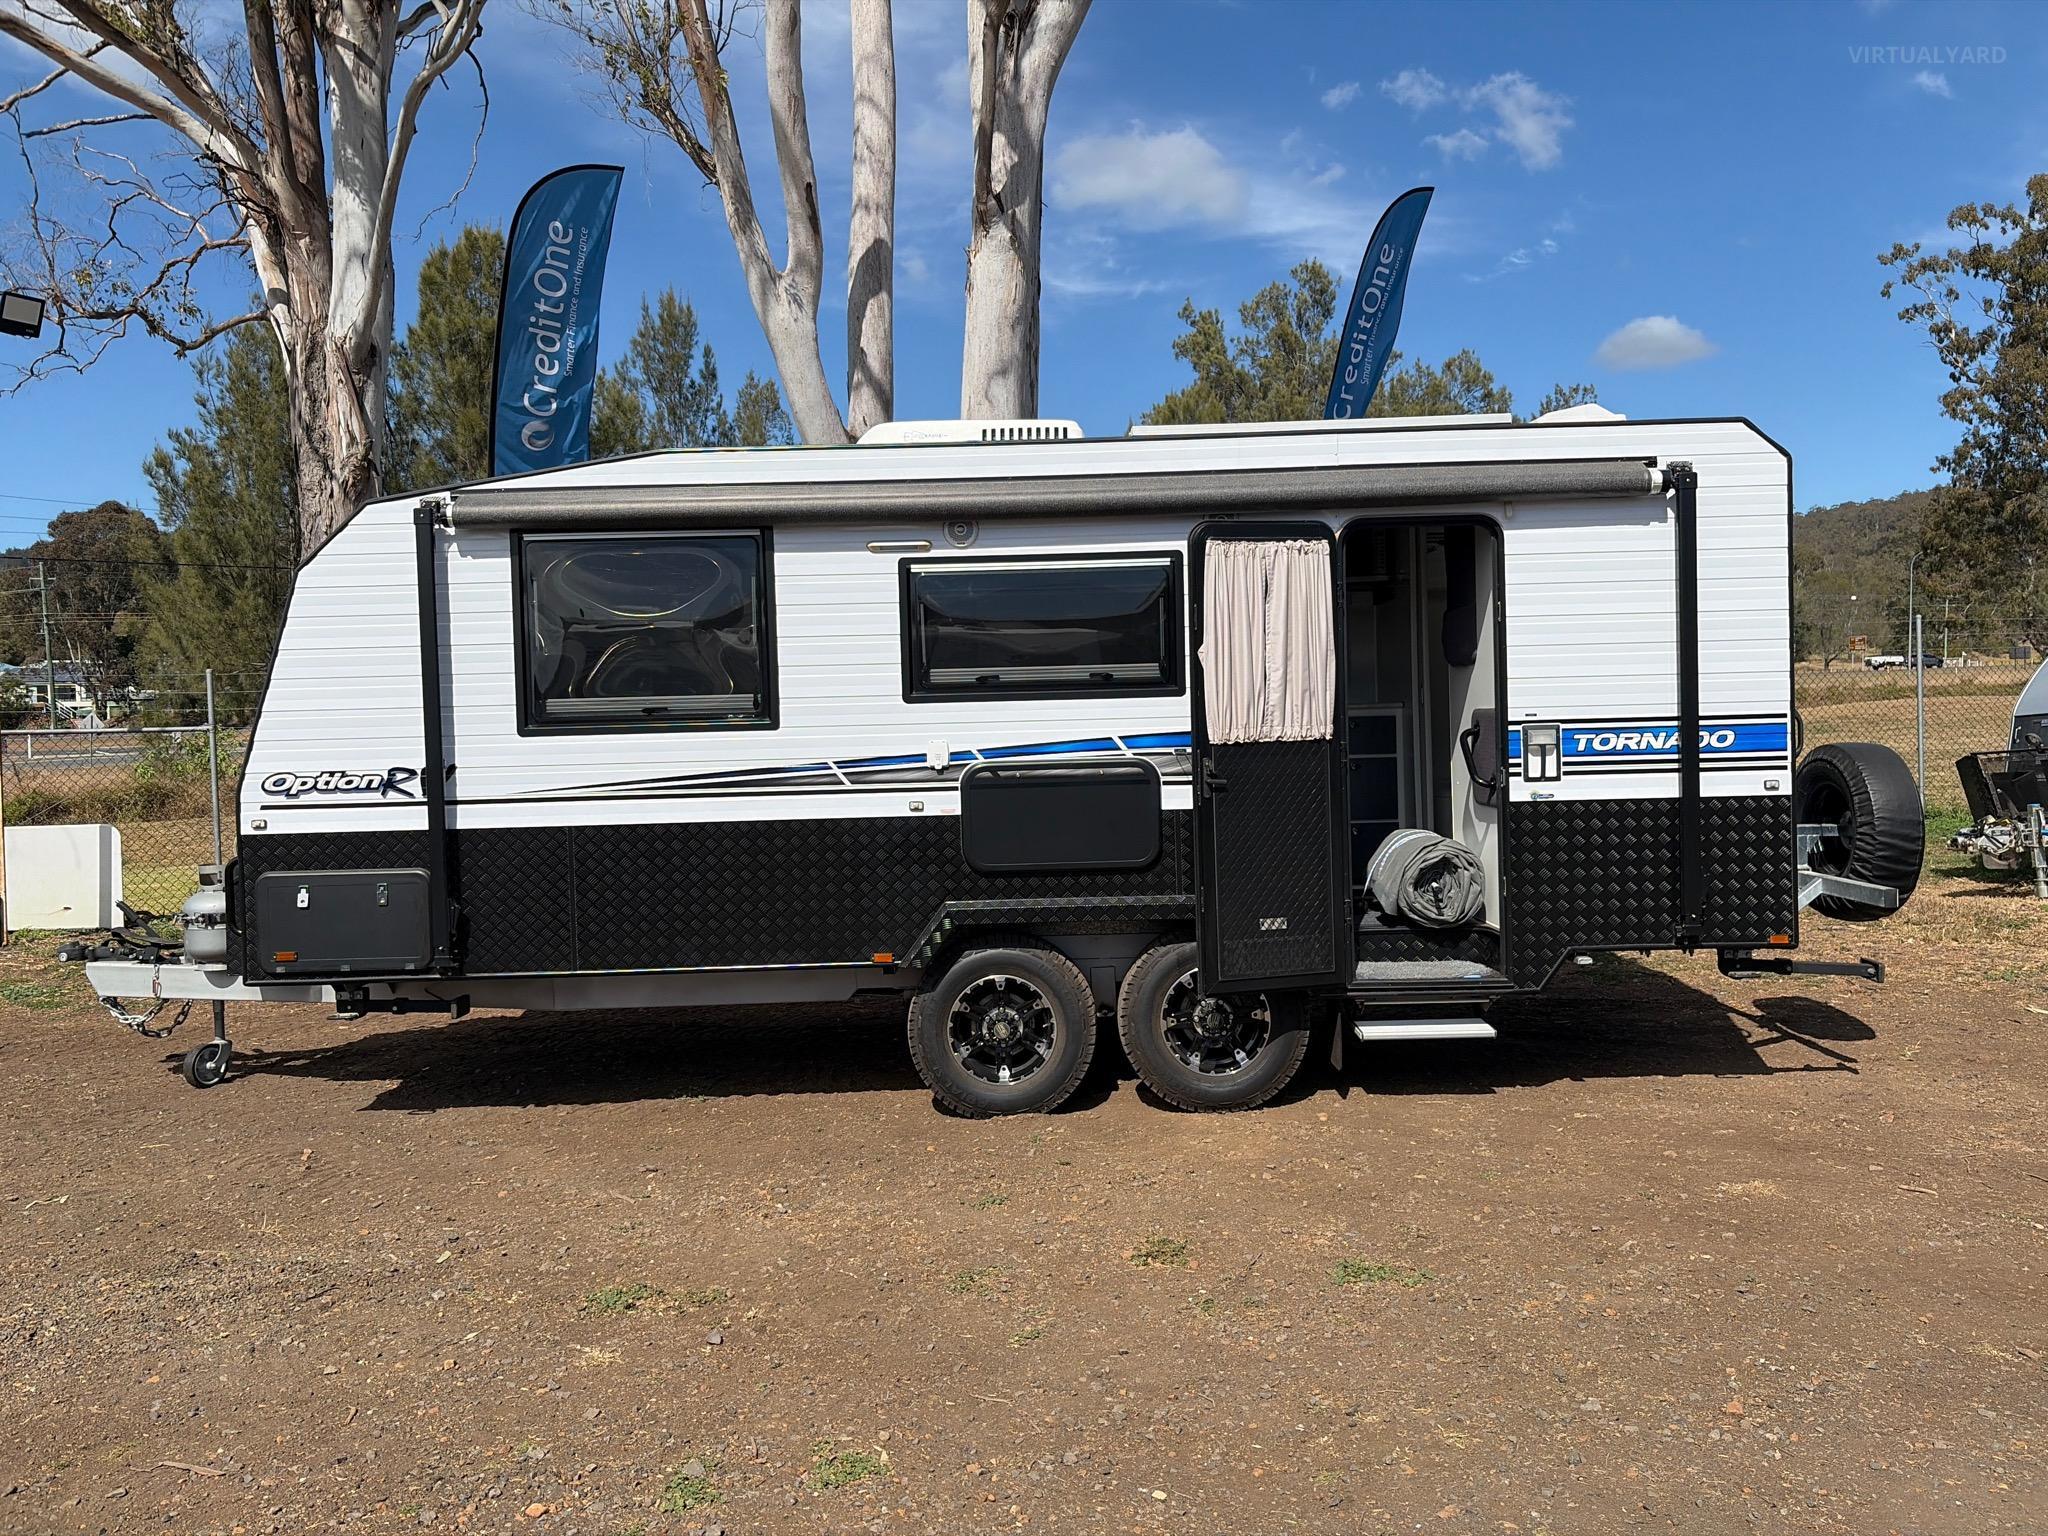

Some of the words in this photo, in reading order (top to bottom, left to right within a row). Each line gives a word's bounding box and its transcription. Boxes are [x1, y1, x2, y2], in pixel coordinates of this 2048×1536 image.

[576, 226, 589, 276] Insurance
[573, 276, 582, 295] and
[523, 220, 573, 417] CreditOne
[566, 297, 579, 336] Finance
[1333, 243, 1394, 420] CreditOne
[1360, 348, 1374, 385] Smarter
[1368, 311, 1382, 347] Finance
[1380, 292, 1389, 310] and
[1387, 247, 1404, 291] Insurance
[563, 338, 577, 377] Smarter
